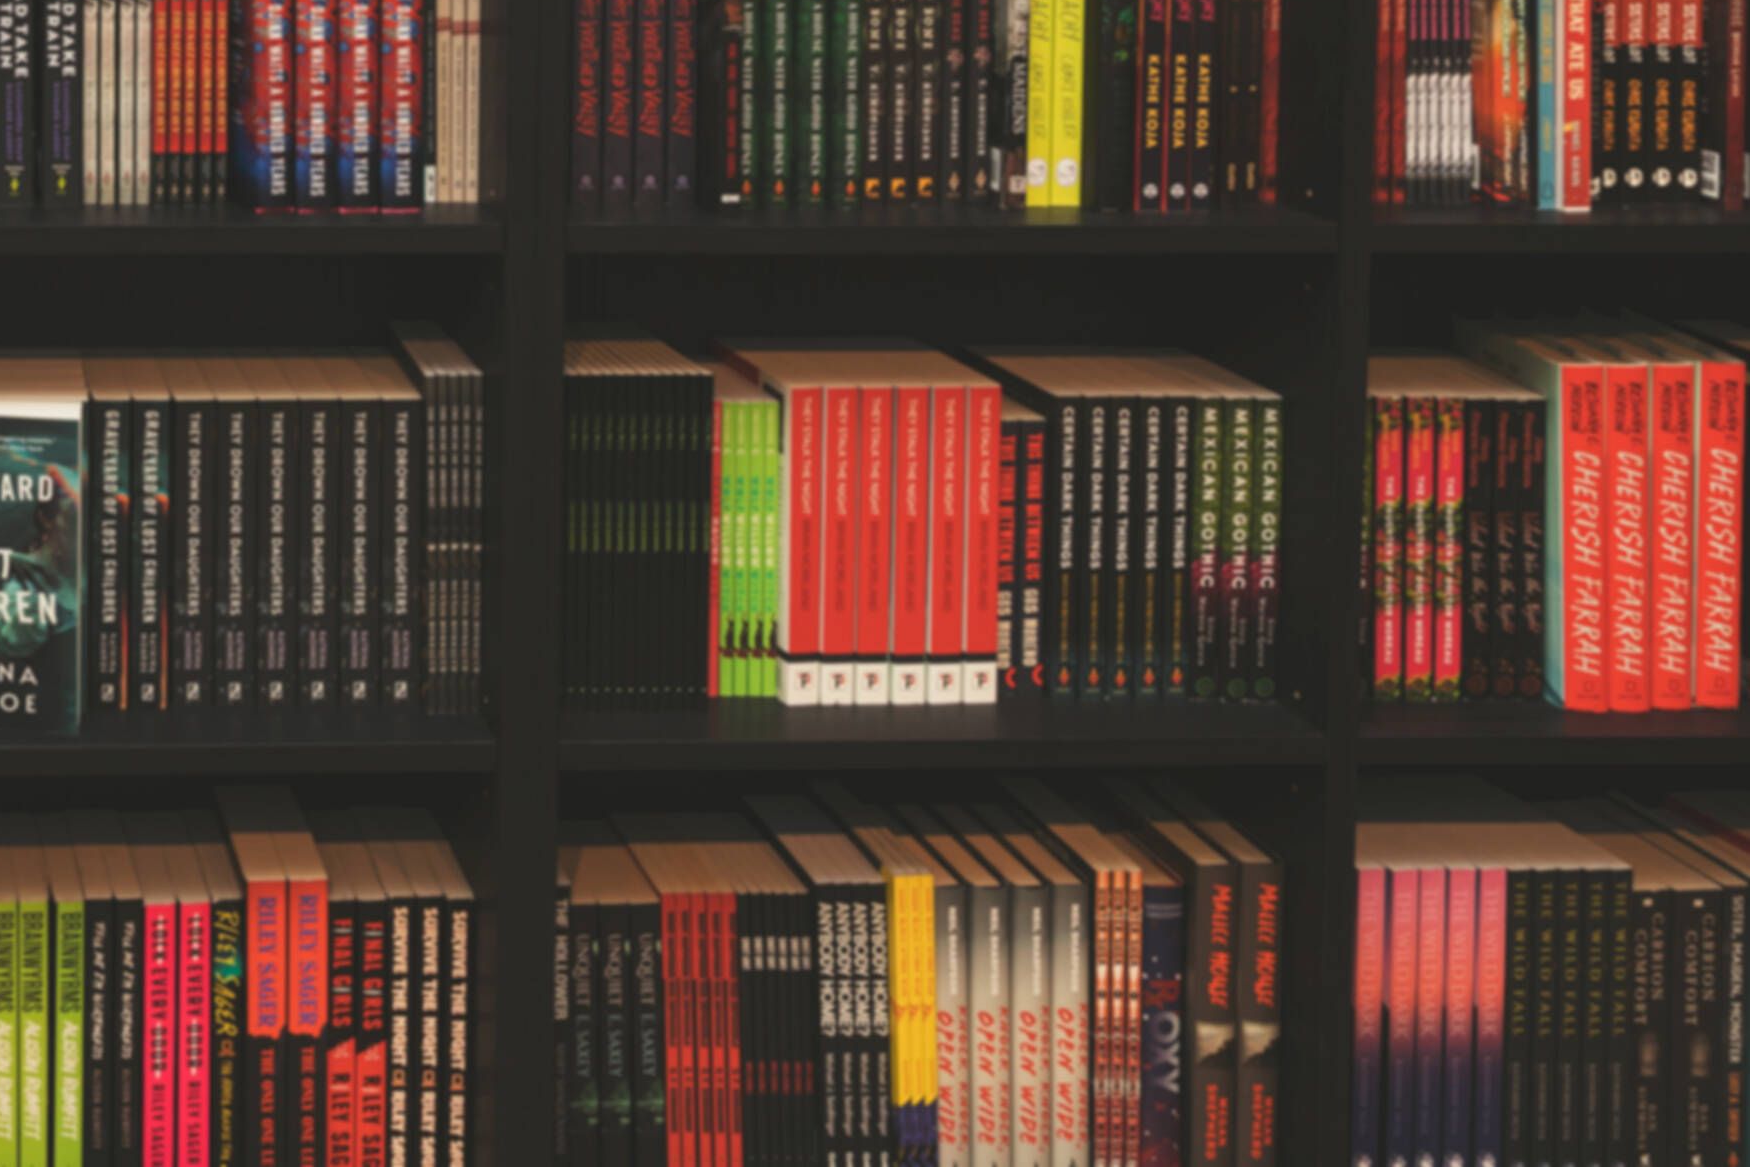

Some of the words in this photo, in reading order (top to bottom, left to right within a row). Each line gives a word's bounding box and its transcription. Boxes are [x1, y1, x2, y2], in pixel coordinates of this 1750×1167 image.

[1175, 54, 1188, 103] KATHE
[1568, 42, 1585, 71] ATE
[1568, 78, 1585, 100] US
[1172, 108, 1186, 149] KOJA
[271, 412, 284, 444] THEY
[1062, 406, 1076, 469] CERTAIN
[1202, 407, 1218, 502] MEXICAN
[270, 448, 283, 501] DROWN
[1061, 472, 1074, 513] DARK
[270, 504, 283, 533] OUR
[1571, 450, 1602, 569] CHERISH
[1060, 516, 1074, 570] THINGS
[1200, 512, 1217, 589] GOTHIC
[270, 537, 283, 616] DAUGHTERS
[1572, 574, 1602, 678] FARRAH
[214, 910, 241, 968] RILEY
[392, 907, 409, 975] SURVIVE
[818, 901, 834, 977] ANYBODY
[213, 972, 240, 1039] SAGER
[392, 978, 408, 1015] THE
[818, 979, 835, 1038] HOME?
[392, 1016, 407, 1066] NIGHT
